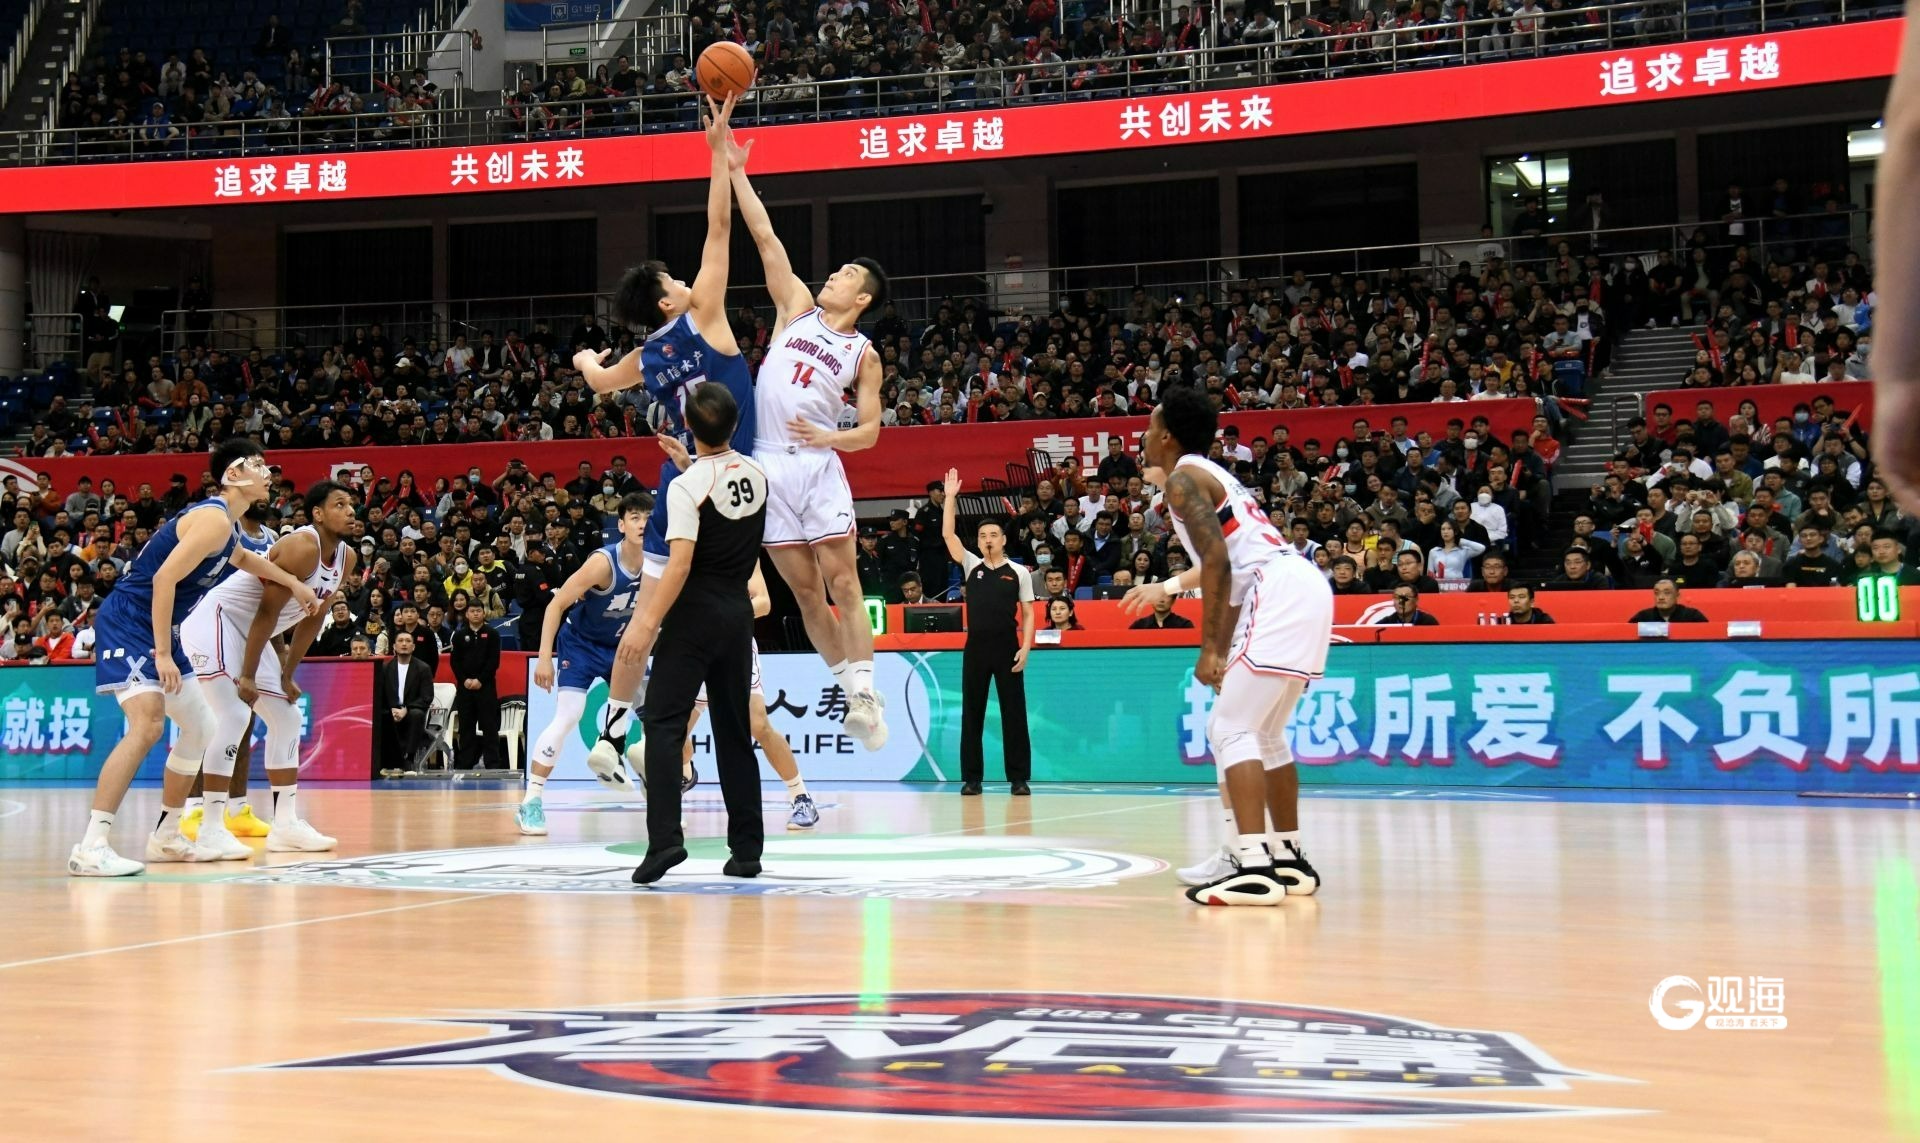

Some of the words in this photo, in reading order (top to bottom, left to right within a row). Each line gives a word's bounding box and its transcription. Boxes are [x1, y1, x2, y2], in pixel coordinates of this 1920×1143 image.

[1599, 41, 1780, 96] 追求卓越
[859, 116, 1005, 160] 追求卓越
[1119, 94, 1274, 141] 共创未来
[214, 159, 347, 197] 追求卓越
[450, 146, 584, 186] 共创未来
[655, 350, 704, 387] 国信水产
[791, 361, 815, 389] 14
[816, 348, 843, 376] LIONS
[727, 477, 755, 508] 39
[1857, 575, 1899, 622] 00
[4, 697, 91, 749] 就投
[1603, 670, 1920, 765] 不负所
[1014, 1008, 1142, 1020] 2023
[1163, 1013, 1367, 1035] CBA
[1387, 1028, 1479, 1042] 2024
[884, 1060, 1508, 1086] PLAYOFFS
